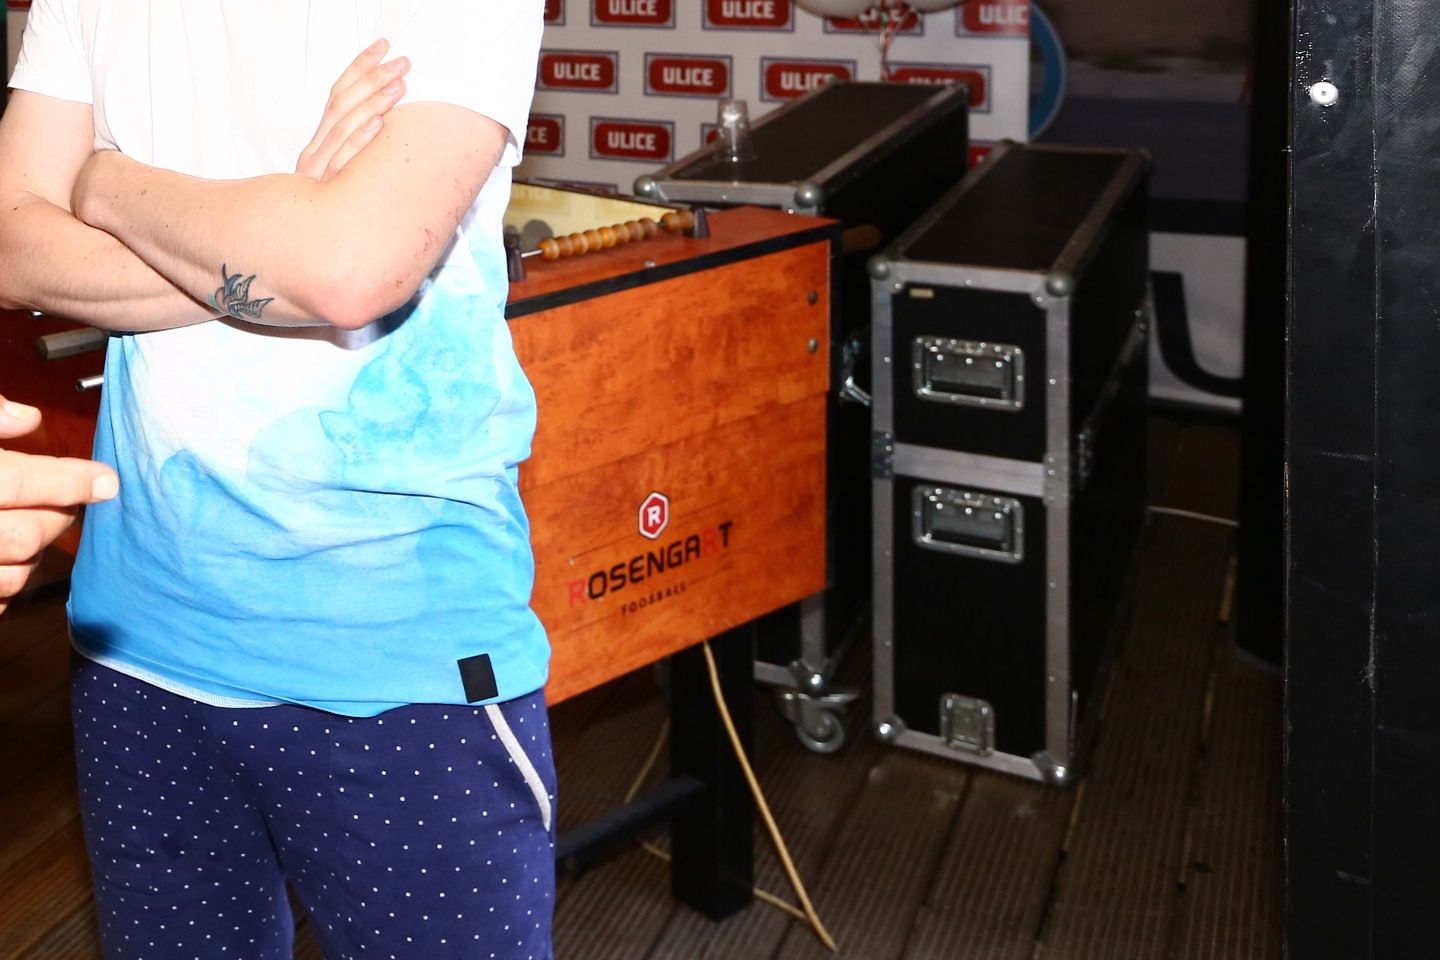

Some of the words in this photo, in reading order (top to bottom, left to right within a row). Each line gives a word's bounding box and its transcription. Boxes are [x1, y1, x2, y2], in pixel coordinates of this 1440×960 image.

[722, 1, 775, 19] ULICE
[979, 5, 1029, 24] ULIC
[554, 62, 601, 81] ULICE
[663, 67, 714, 86] ULICE
[608, 132, 656, 151] ULICE
[647, 505, 661, 527] R
[568, 521, 733, 608] ROSENGART
